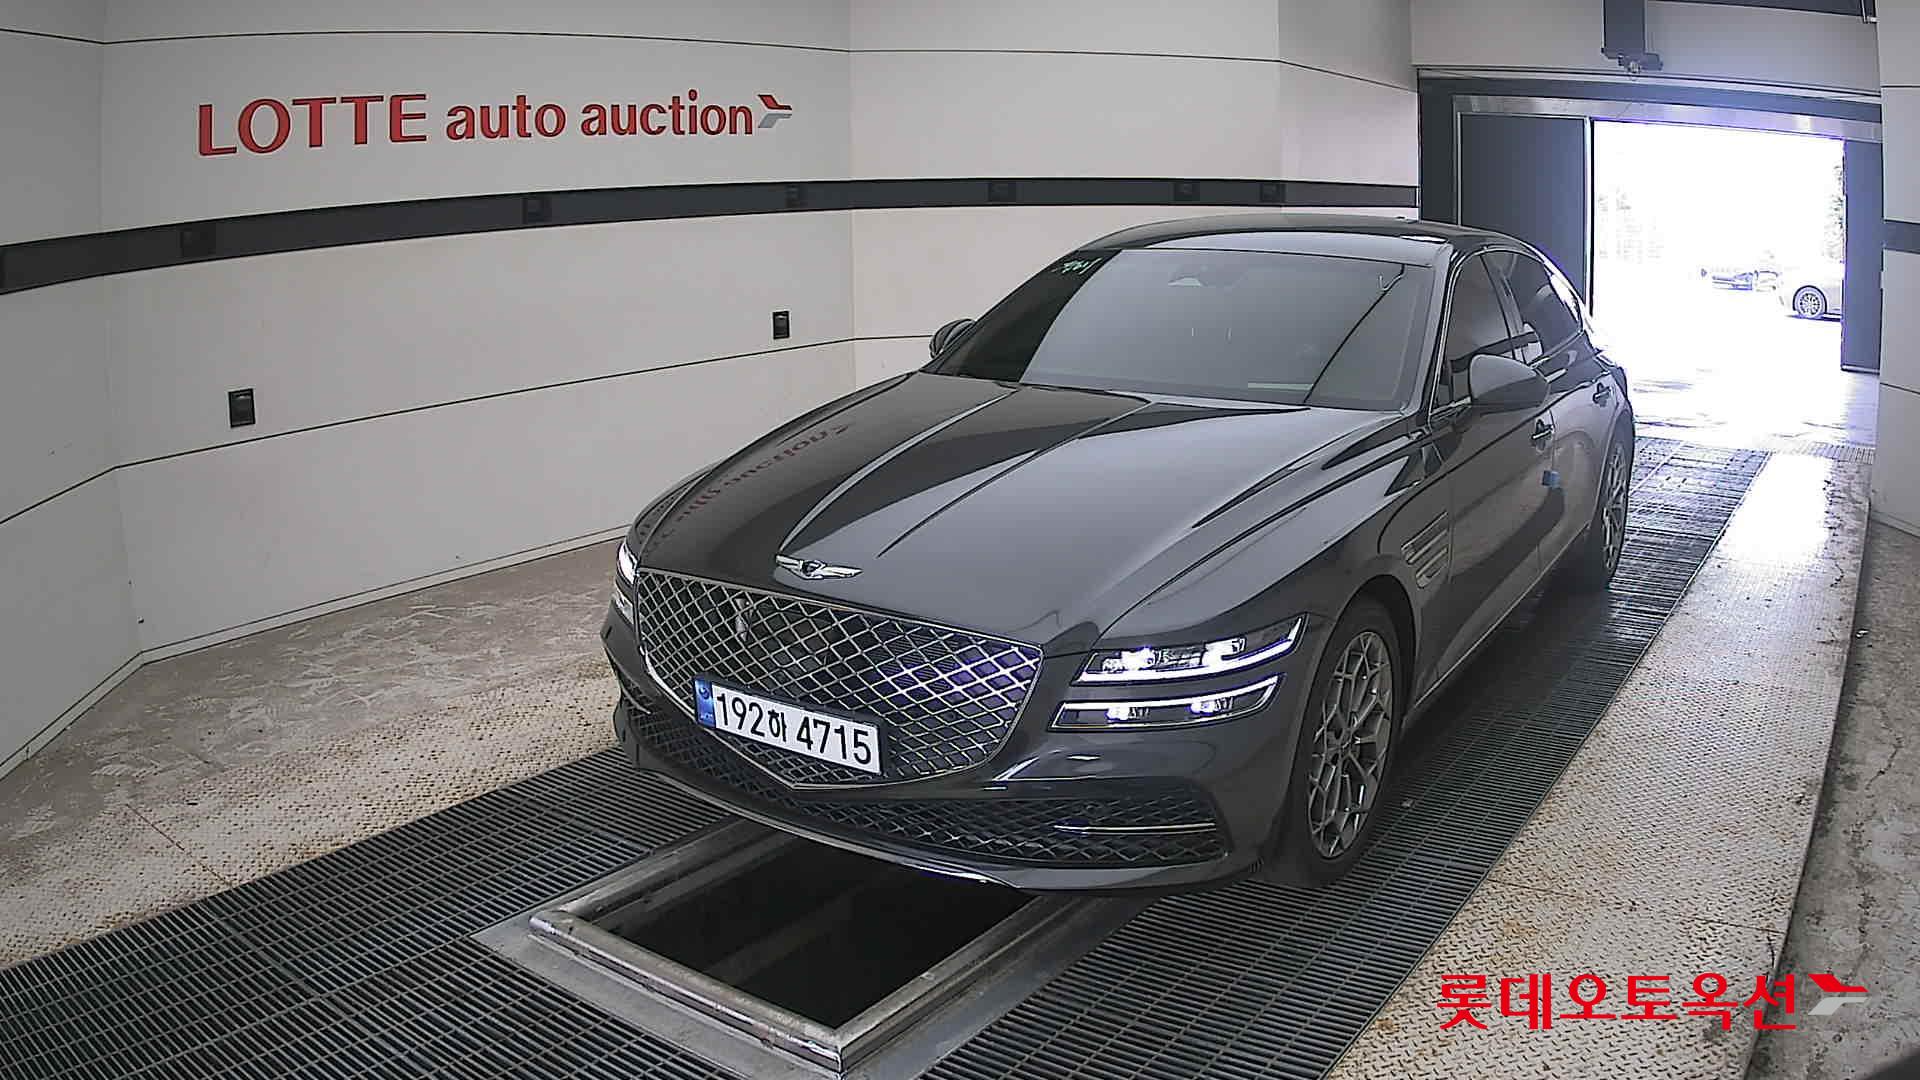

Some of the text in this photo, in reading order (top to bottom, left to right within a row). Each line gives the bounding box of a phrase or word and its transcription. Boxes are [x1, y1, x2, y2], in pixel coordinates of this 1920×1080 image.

[198, 88, 754, 156] LOTTE auto auction
[716, 692, 872, 765] 192하 4715
